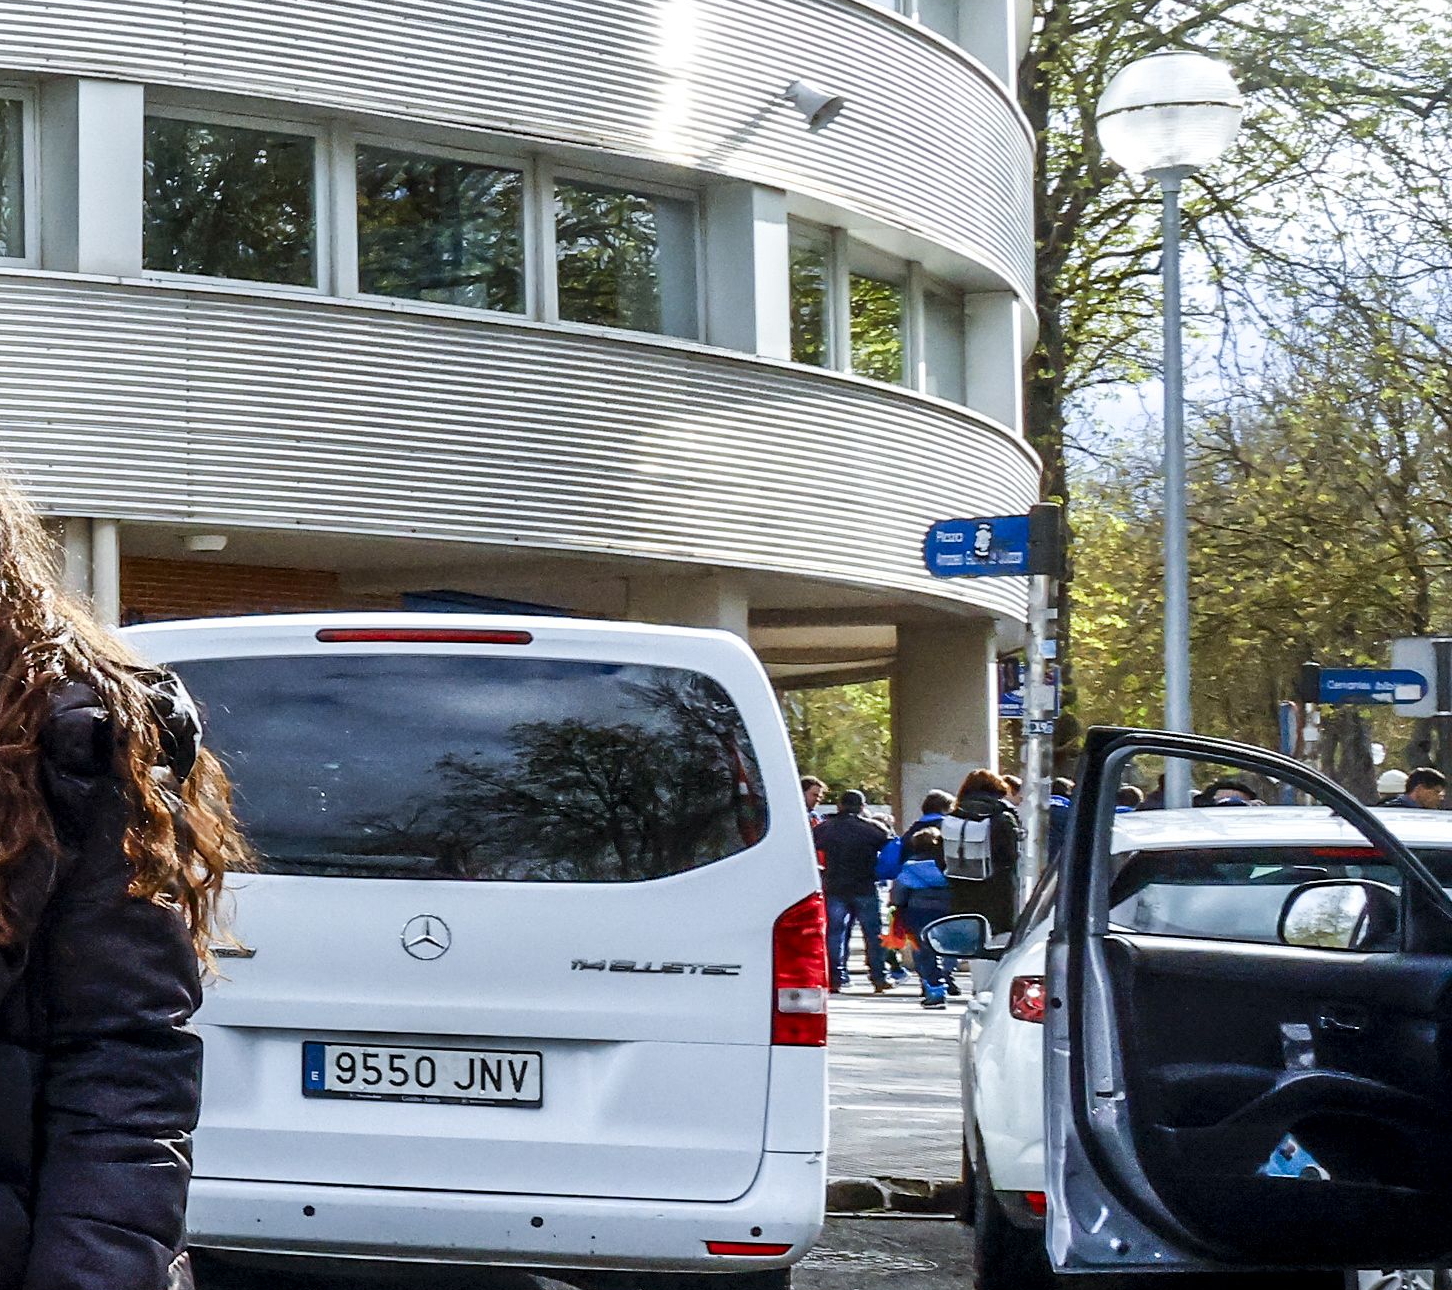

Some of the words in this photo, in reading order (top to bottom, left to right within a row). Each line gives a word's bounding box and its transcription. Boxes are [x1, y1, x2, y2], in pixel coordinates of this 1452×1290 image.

[311, 1071, 319, 1081] E
[335, 1051, 436, 1088] 9550
[454, 1057, 529, 1093] JNV
